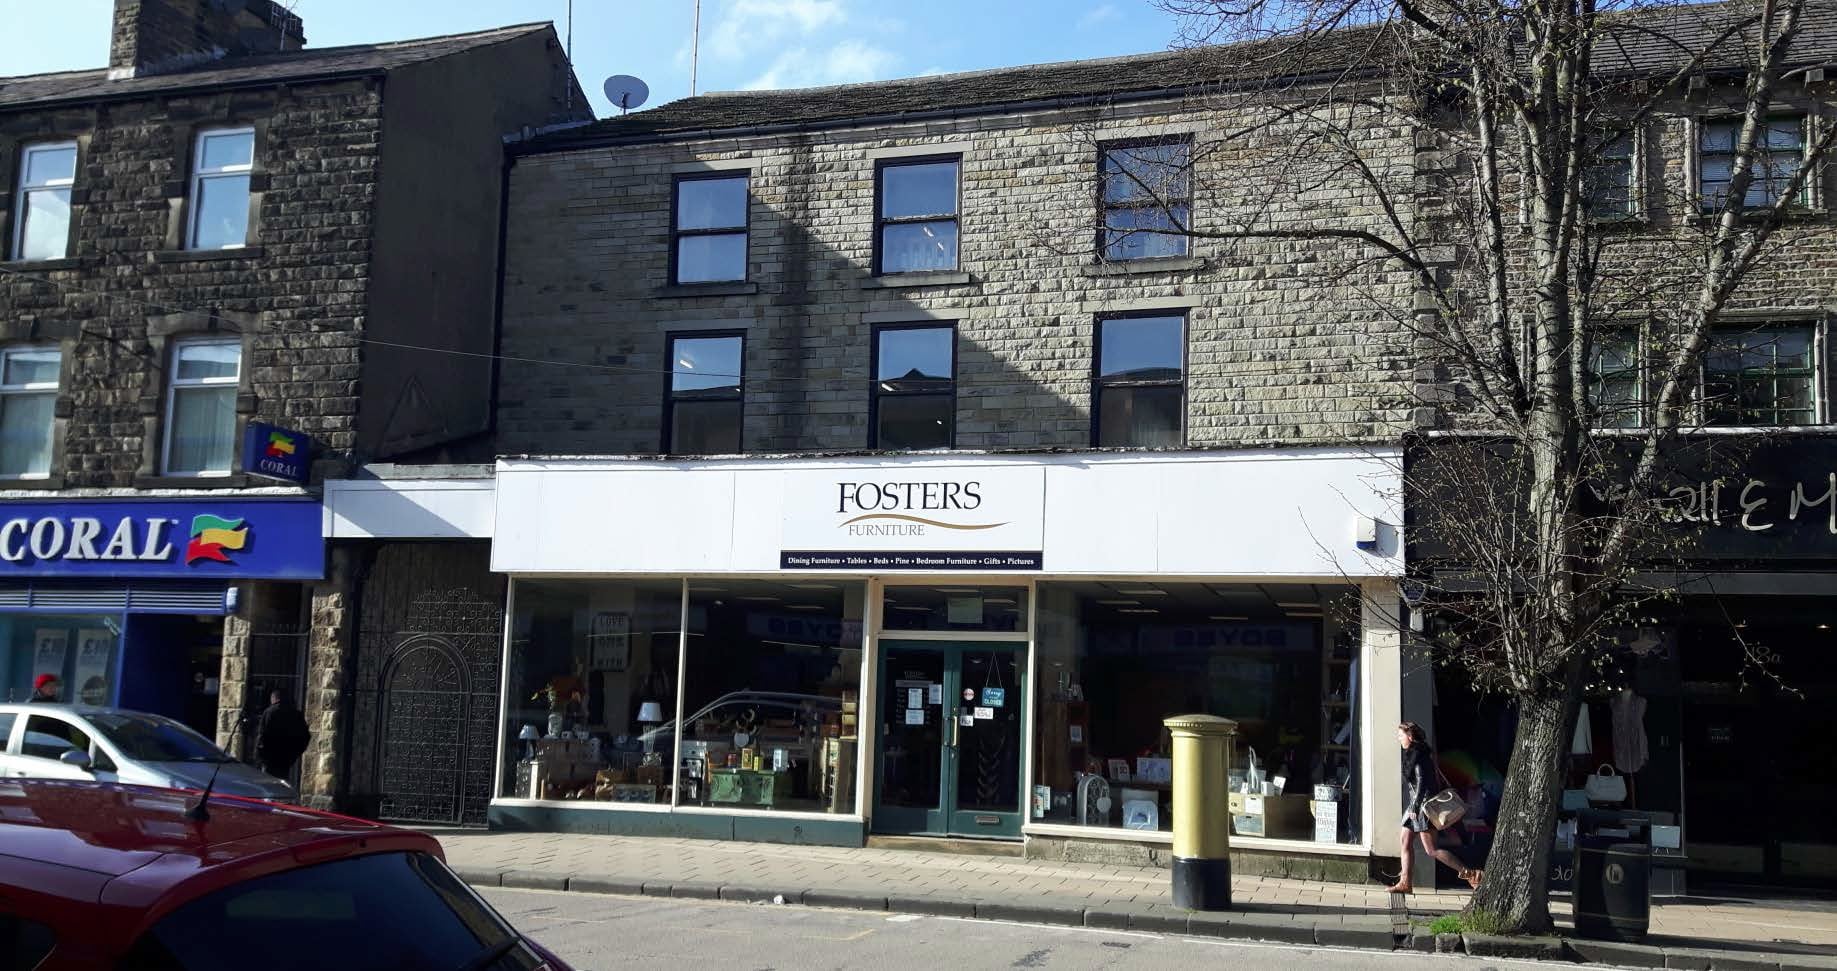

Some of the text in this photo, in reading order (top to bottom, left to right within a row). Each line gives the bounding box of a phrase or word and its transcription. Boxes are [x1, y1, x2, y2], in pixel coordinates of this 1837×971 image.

[260, 459, 297, 476] CORAL
[836, 481, 982, 513] FOSTERS
[0, 516, 173, 561] CORAL
[849, 524, 925, 536] FURNITURE
[787, 557, 1034, 566] Dining Furniture Tables Beds Pine Bedroom Furniture Gifts Pictures
